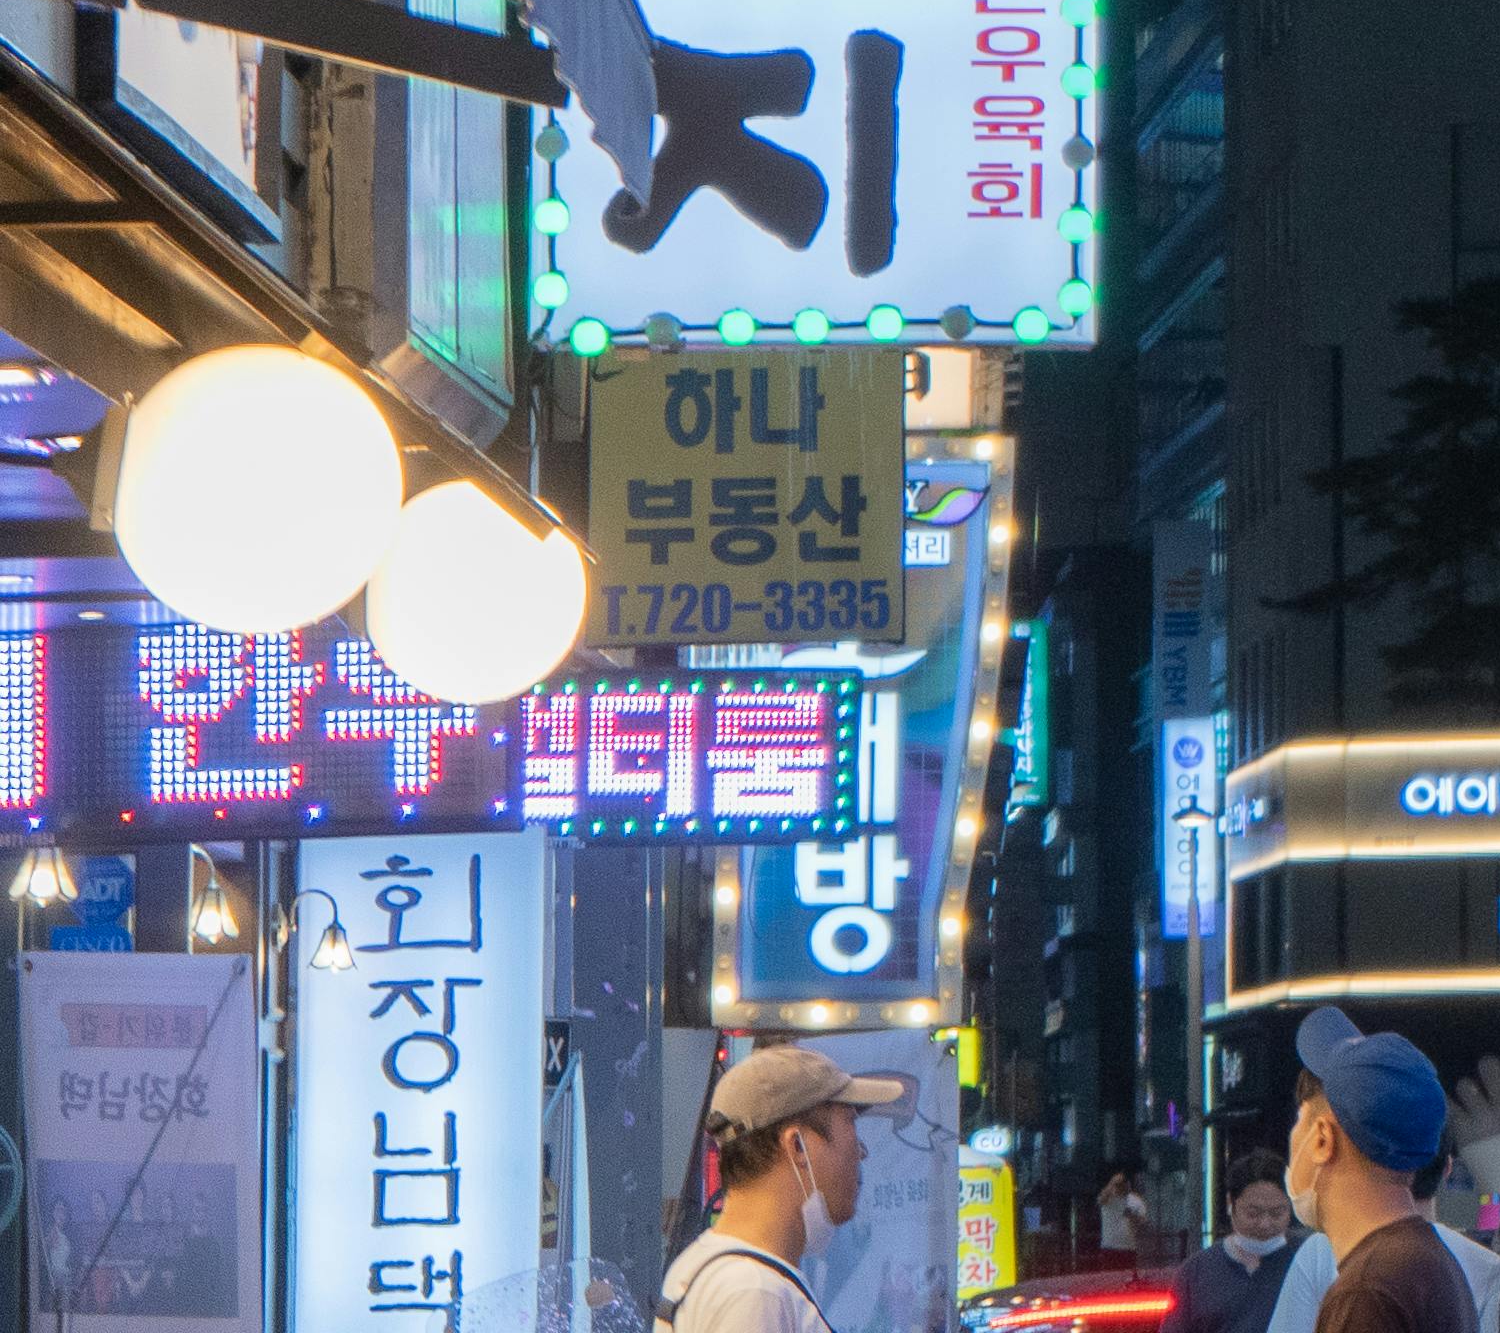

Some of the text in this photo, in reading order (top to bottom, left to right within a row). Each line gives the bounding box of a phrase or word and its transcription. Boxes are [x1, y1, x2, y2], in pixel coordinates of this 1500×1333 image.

[665, 366, 827, 456] 하나
[625, 475, 868, 568] 부동산
[600, 578, 892, 639] T.720-3335
[980, 1135, 1005, 1150] CU
[958, 1181, 992, 1203] 계
